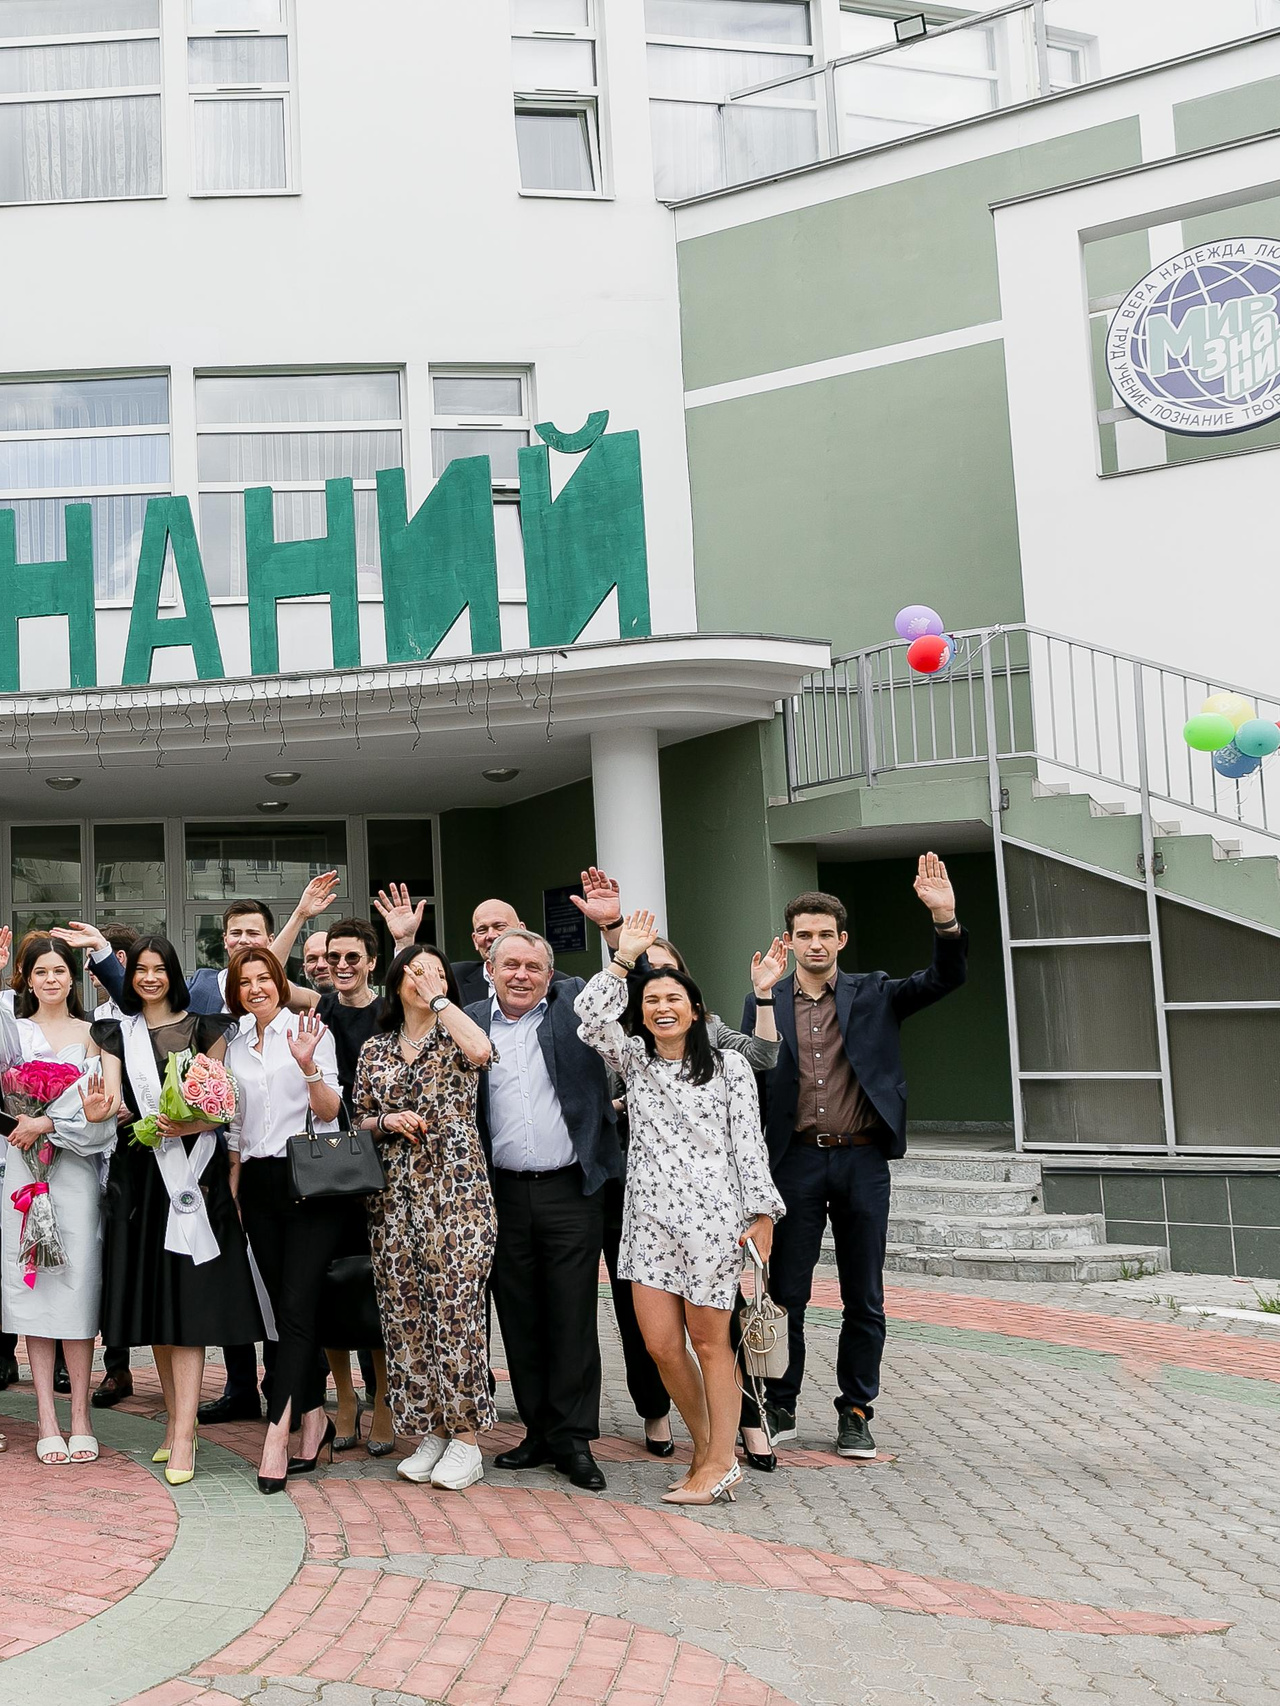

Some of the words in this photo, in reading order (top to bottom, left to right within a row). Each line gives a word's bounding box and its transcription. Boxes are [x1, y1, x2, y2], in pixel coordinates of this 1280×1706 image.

[1122, 283, 1158, 319] ВЕРА
[1159, 243, 1246, 281] НАДЕЖДА
[1110, 327, 1129, 361] ТРУД
[1115, 362, 1152, 408] УЧЕНИЕ
[1150, 404, 1235, 427] ПОЗНАНИЕ
